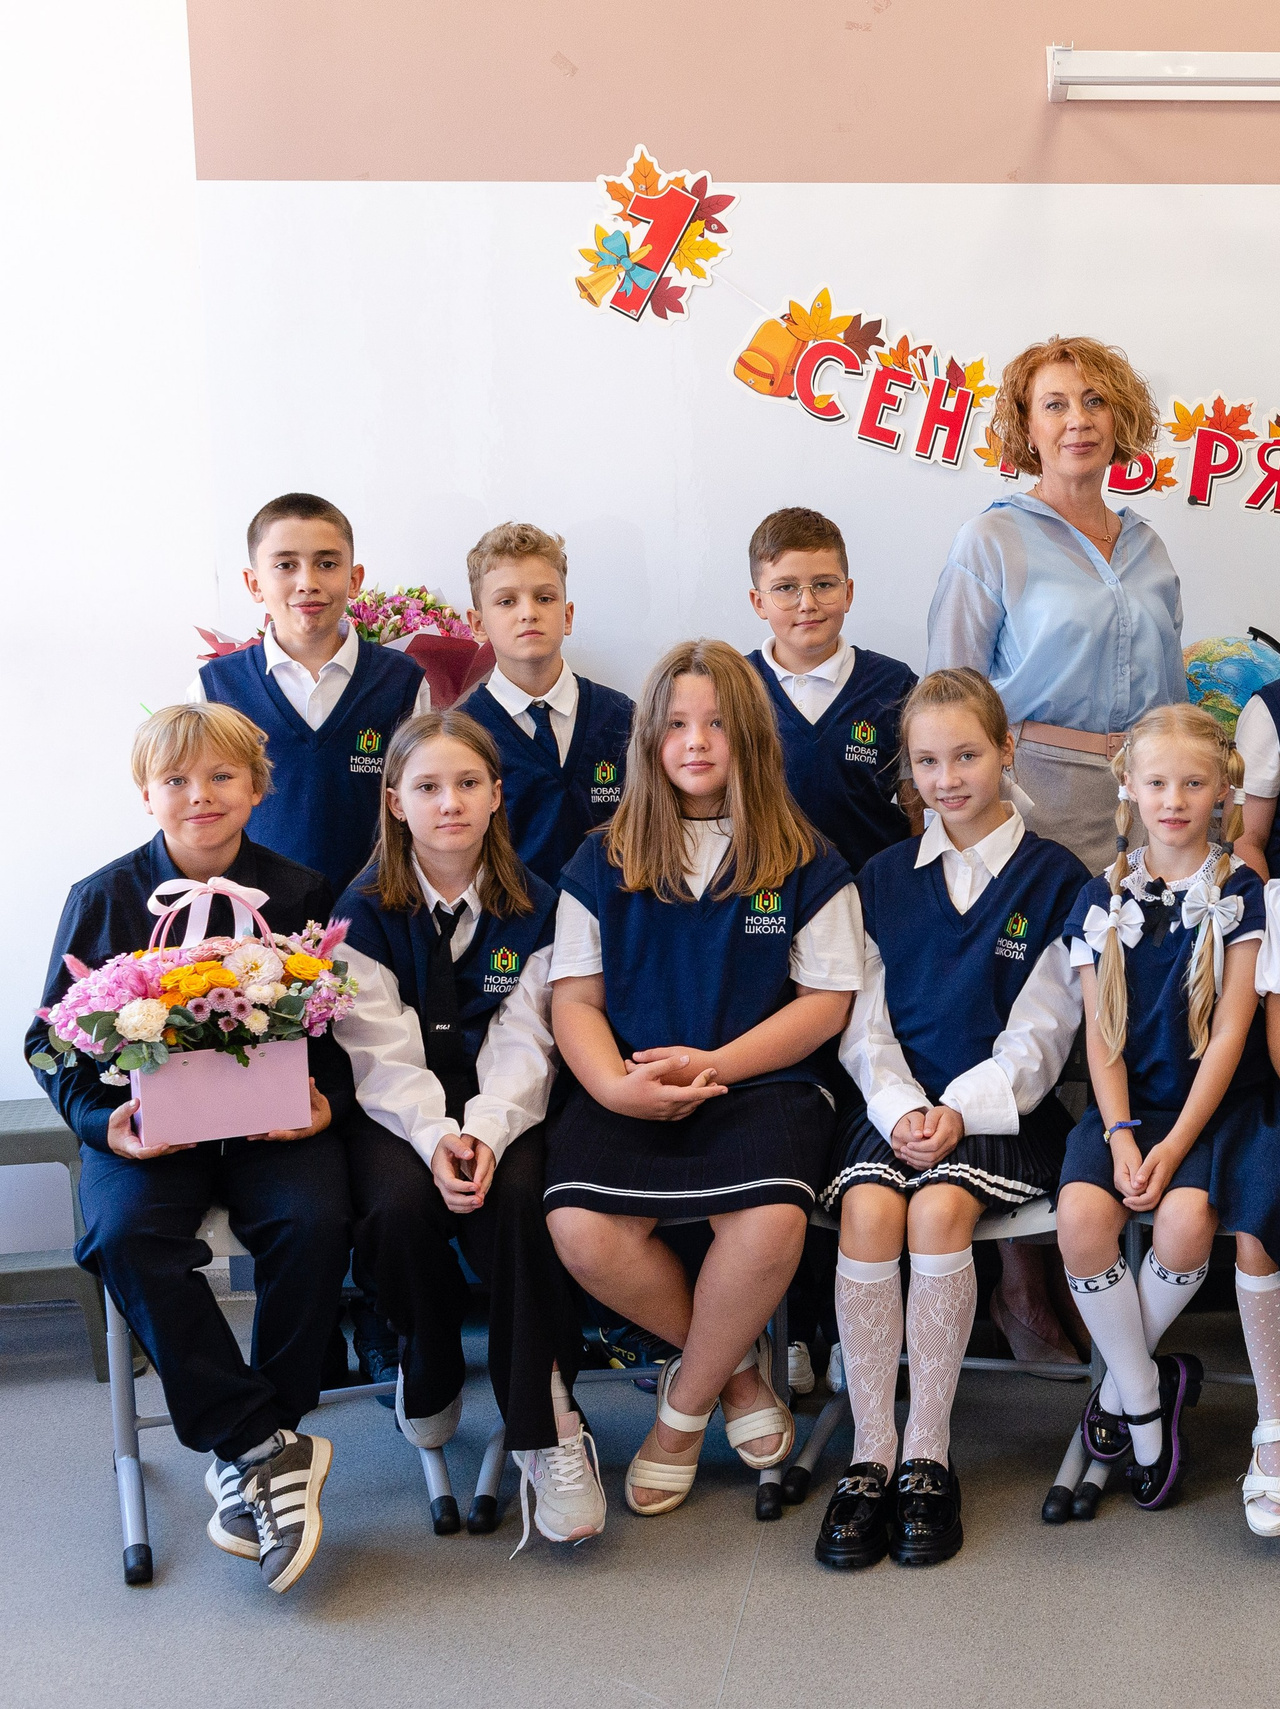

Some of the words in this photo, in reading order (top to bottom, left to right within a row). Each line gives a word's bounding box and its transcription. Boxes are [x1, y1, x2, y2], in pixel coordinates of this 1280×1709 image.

[607, 184, 700, 323] 1
[845, 744, 878, 757] НОВАЯ
[350, 755, 384, 766] НОВАЯ
[845, 753, 877, 765] ШКОЛА
[350, 764, 383, 774] ШКОЛА
[590, 787, 621, 796] НОВАЯ
[591, 795, 621, 803] ШКОЛА
[745, 916, 786, 925] НОВАЯ
[745, 925, 786, 934] ШКОЛА
[997, 937, 1027, 952] НОВАЯ
[995, 946, 1025, 961] ШКОЛА
[484, 975, 520, 985] НОВАЯ
